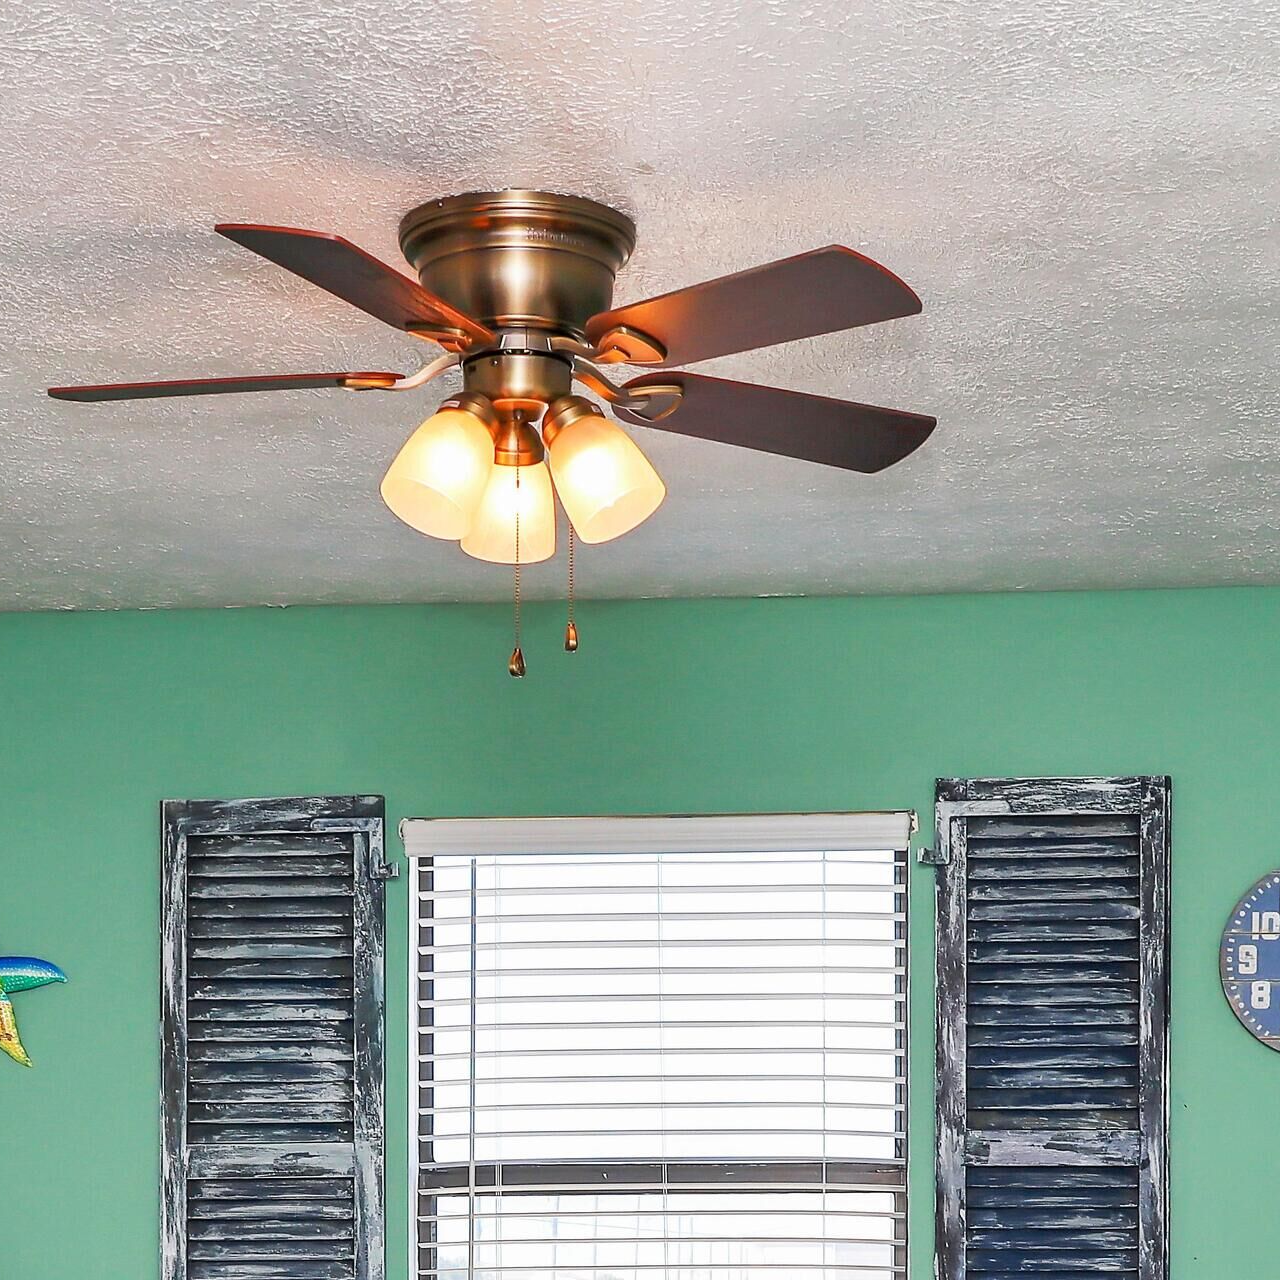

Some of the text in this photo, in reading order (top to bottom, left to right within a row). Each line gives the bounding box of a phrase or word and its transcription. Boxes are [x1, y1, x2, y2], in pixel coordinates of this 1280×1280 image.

[1251, 911, 1280, 941] 10
[1238, 944, 1258, 975] 9
[1251, 981, 1271, 1010] 8
